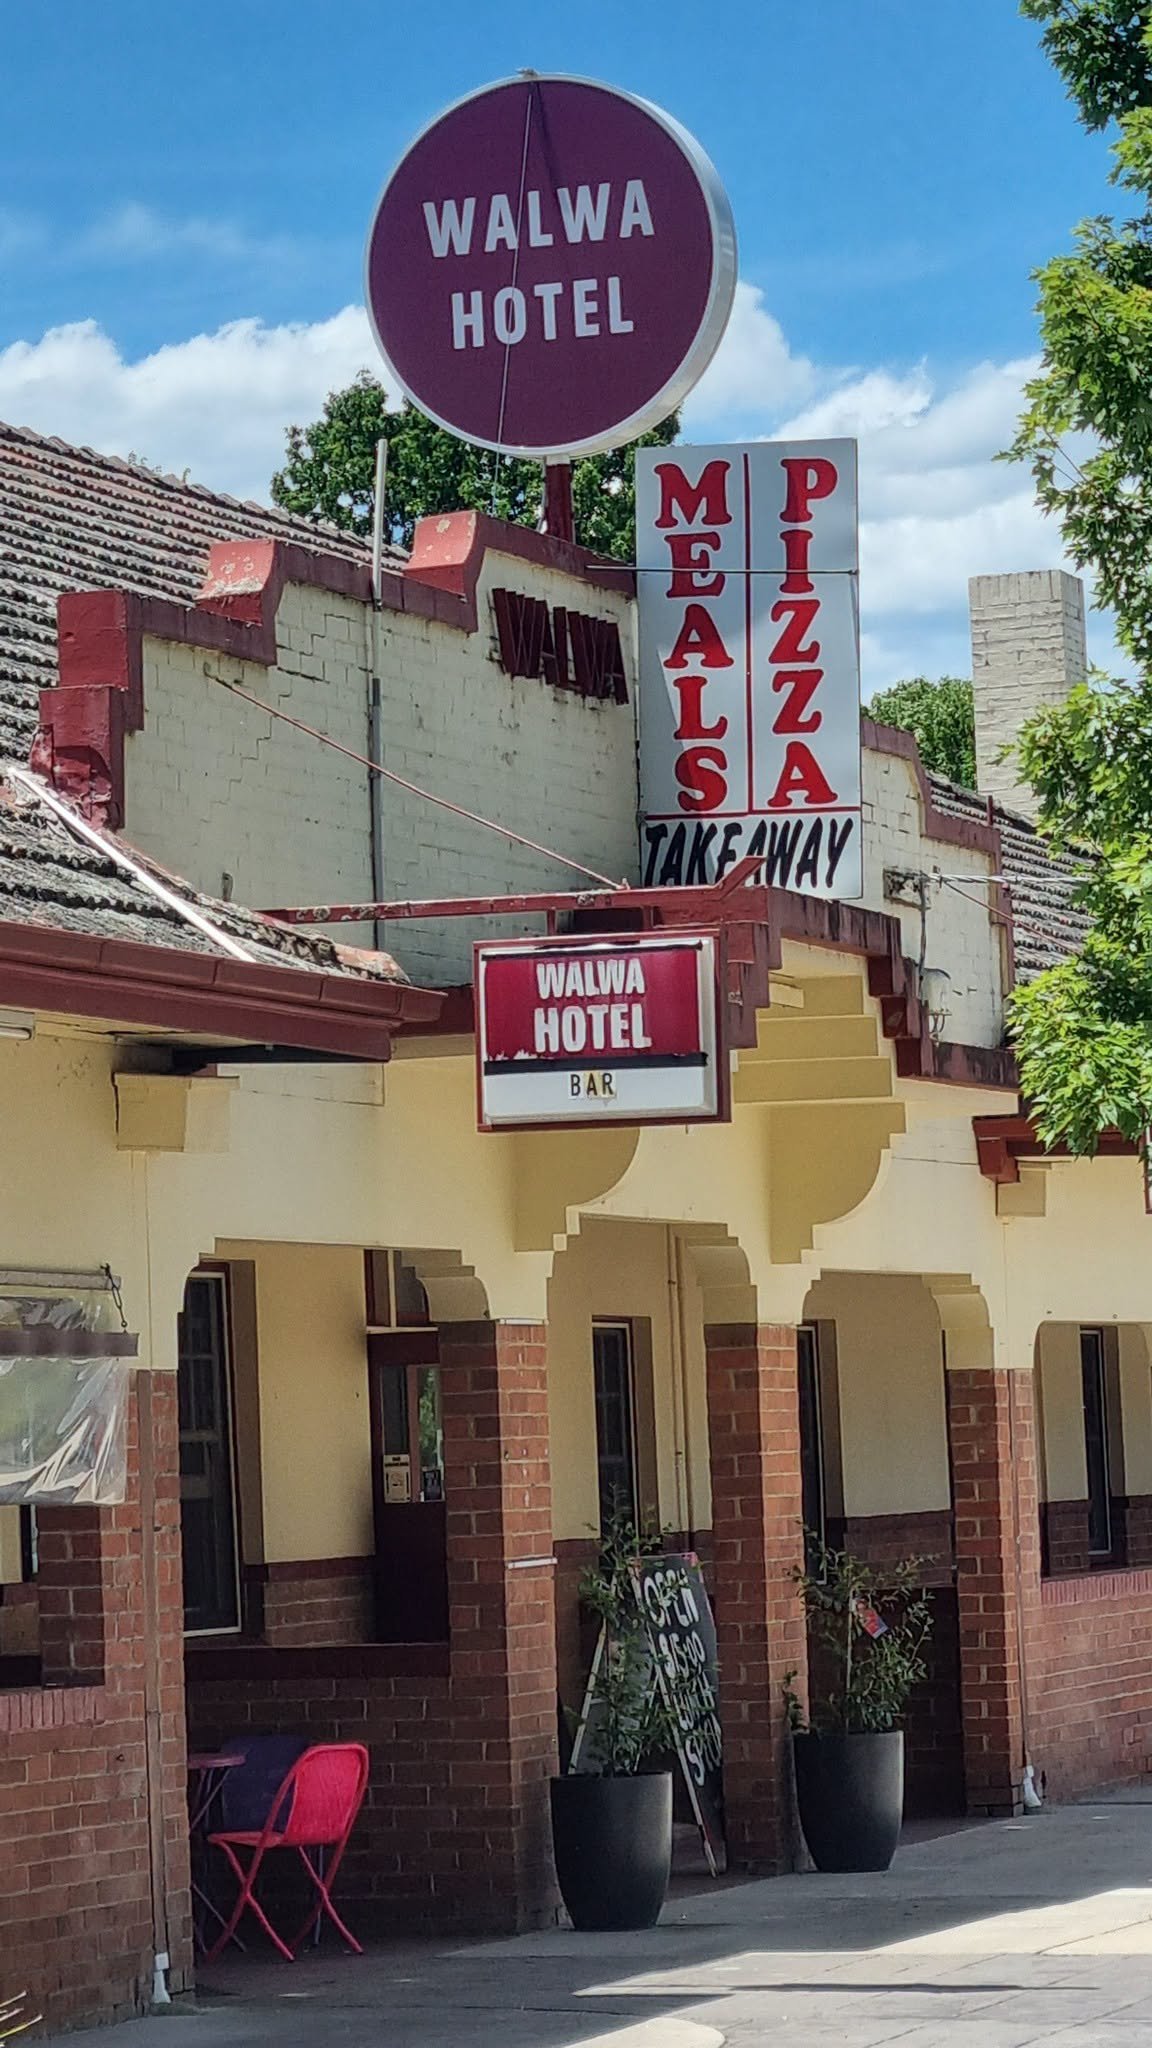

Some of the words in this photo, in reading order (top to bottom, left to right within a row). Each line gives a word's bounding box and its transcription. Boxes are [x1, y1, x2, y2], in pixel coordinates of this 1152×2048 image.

[423, 179, 655, 258] WALWA
[451, 276, 635, 350] HOTEL
[654, 459, 734, 812] MEALS
[767, 457, 839, 808] PIZZA
[536, 958, 646, 999] WALWA
[534, 1003, 653, 1053] HOTEL
[571, 1072, 614, 1097] BAR
[643, 1567, 700, 1628] OPEN
